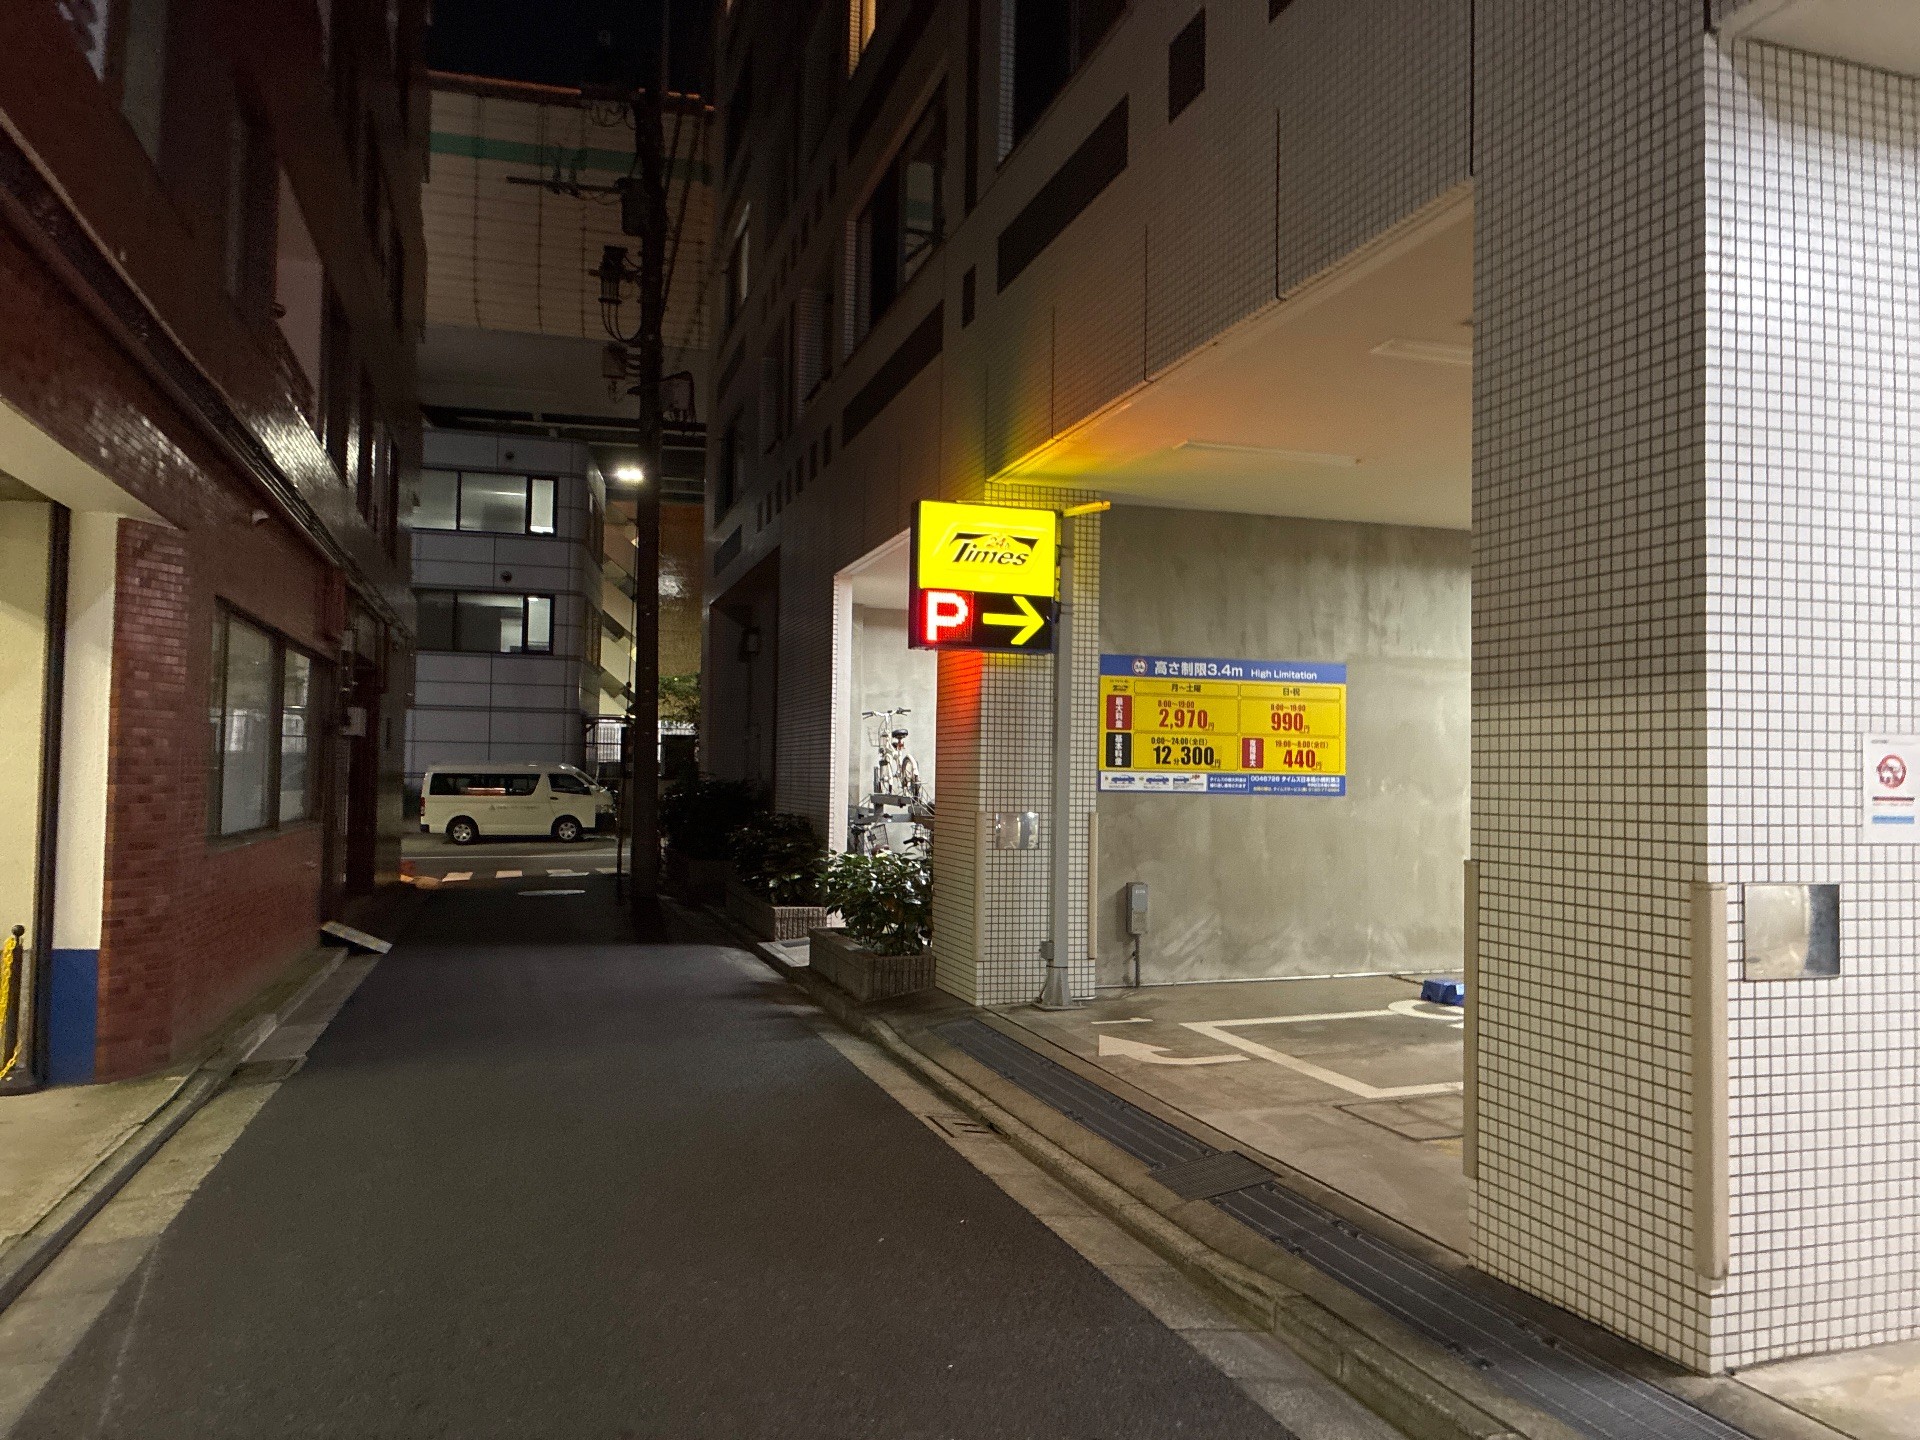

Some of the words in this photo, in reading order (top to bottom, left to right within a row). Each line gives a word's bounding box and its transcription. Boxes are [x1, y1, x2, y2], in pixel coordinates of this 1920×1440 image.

[949, 532, 1031, 566] Times
[926, 590, 969, 642] P
[1154, 660, 1243, 677] 高さ制限3.4m
[1251, 668, 1272, 679] High
[1273, 669, 1318, 680] Limitation
